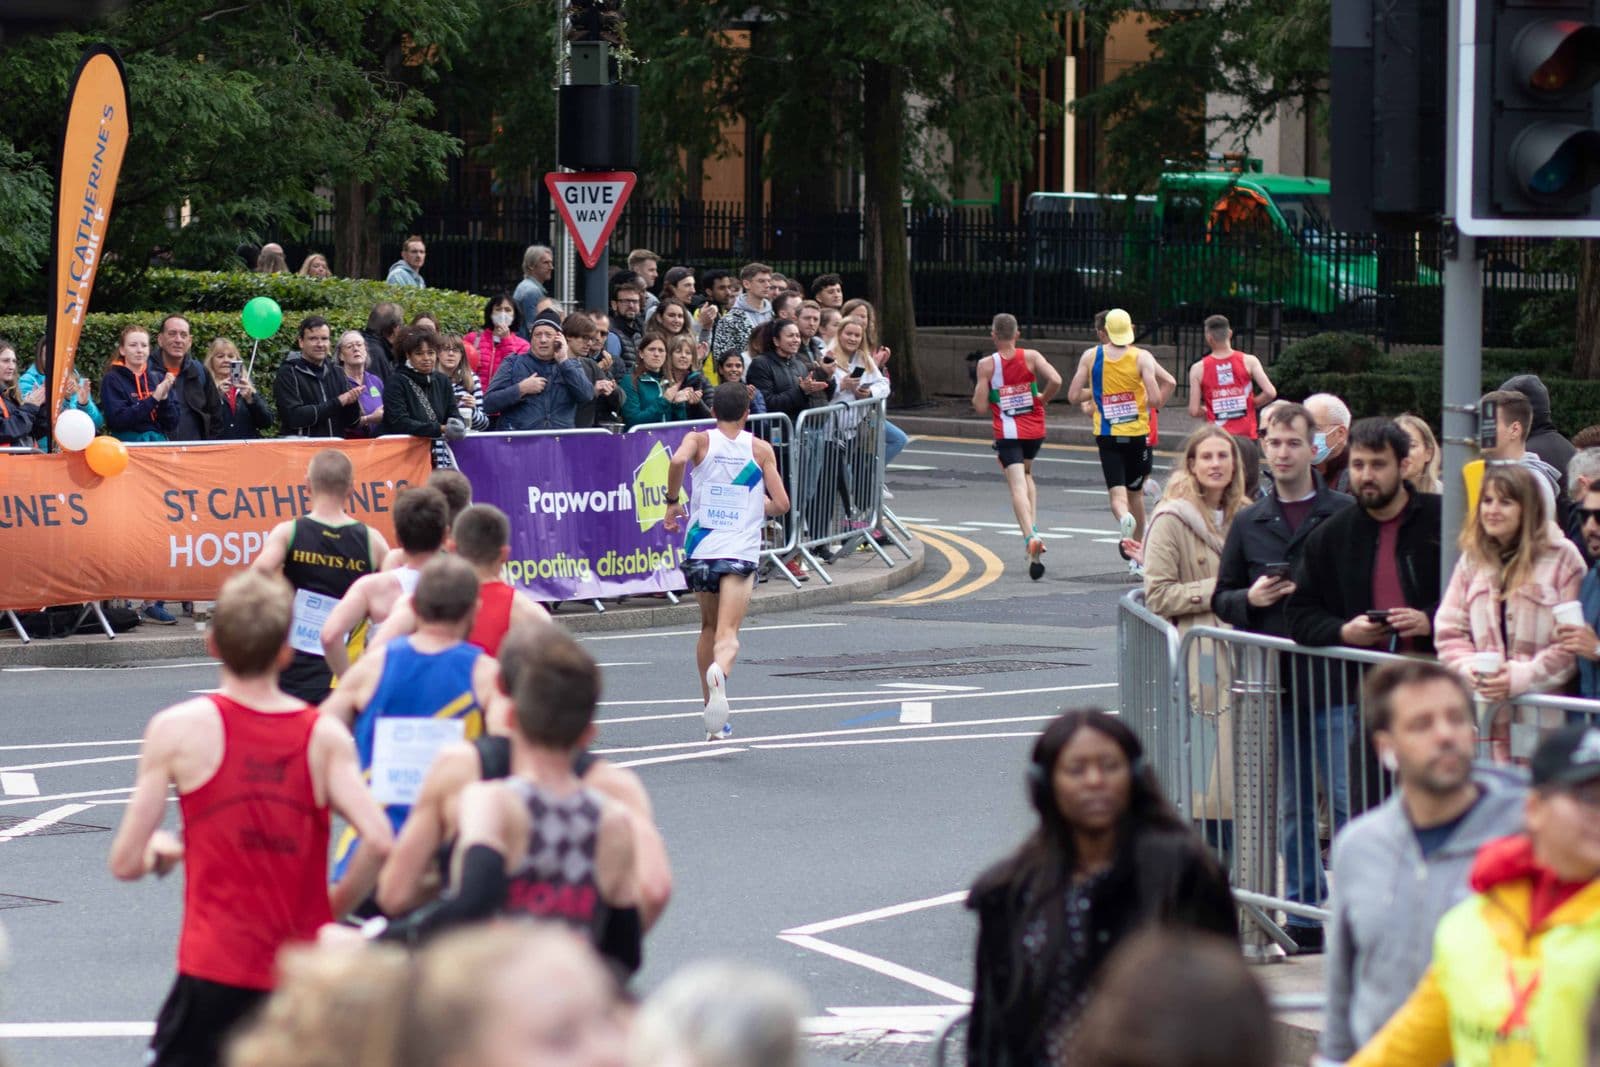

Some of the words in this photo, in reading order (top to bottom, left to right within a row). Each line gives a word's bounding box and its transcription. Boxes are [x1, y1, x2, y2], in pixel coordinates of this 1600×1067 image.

[69, 104, 114, 283] CATHERINE'S
[565, 186, 613, 204] GIVE
[576, 210, 606, 222] WAY
[0, 493, 88, 528] INE'S
[207, 480, 409, 520] CATHENE'
[528, 483, 632, 520] Papworth
[639, 481, 668, 507] Trus
[707, 509, 739, 520] M40-44
[293, 550, 344, 569] HUNTS
[346, 558, 366, 572] AC
[501, 552, 591, 585] upporting
[597, 543, 674, 577] disabled
[296, 625, 321, 642] M40
